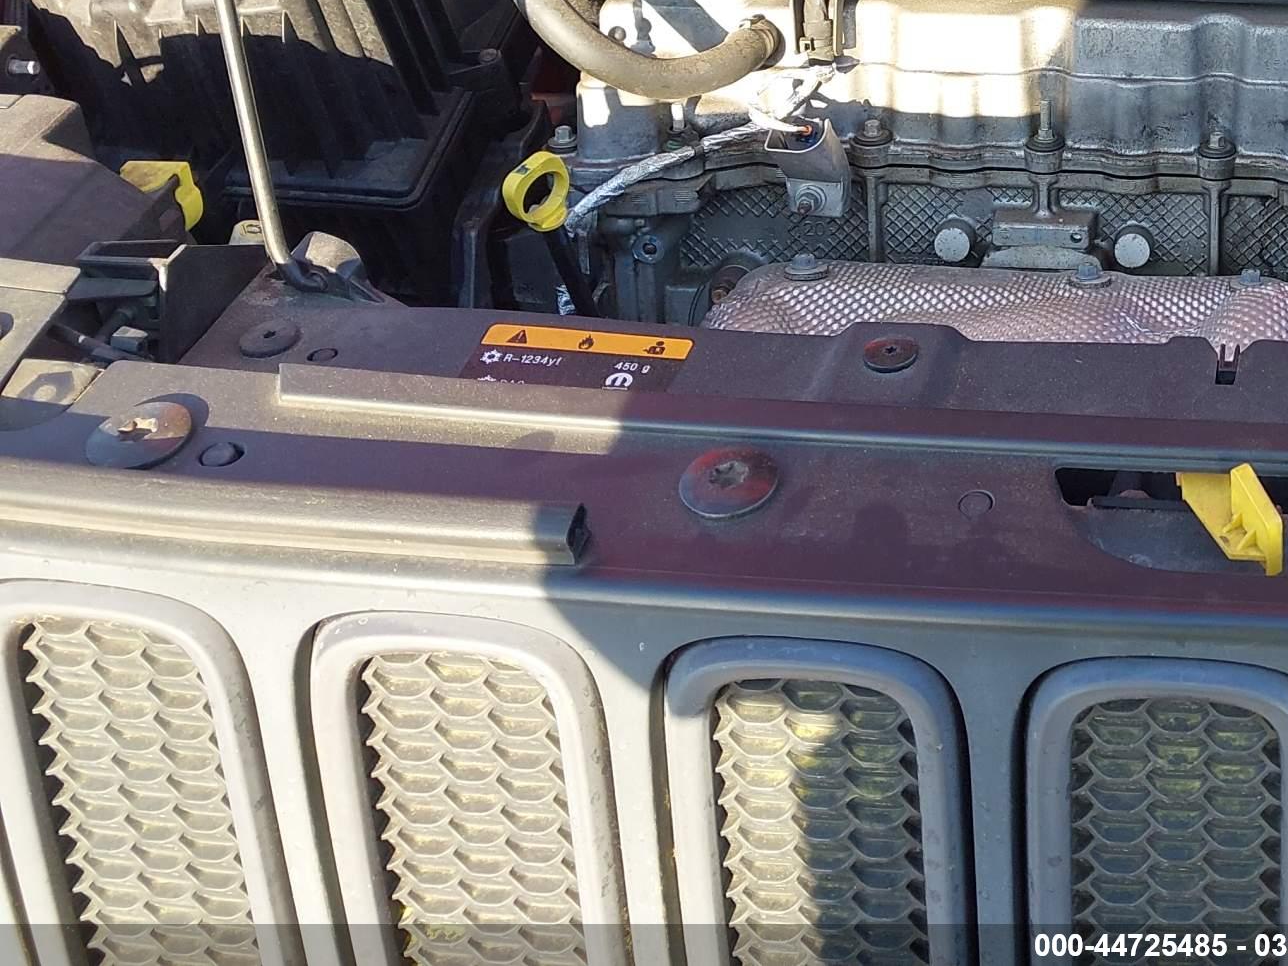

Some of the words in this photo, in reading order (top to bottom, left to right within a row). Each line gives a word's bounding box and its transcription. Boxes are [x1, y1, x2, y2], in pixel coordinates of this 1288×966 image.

[502, 353, 563, 367] R-1234yf
[613, 361, 638, 371] 450
[641, 364, 651, 374] g
